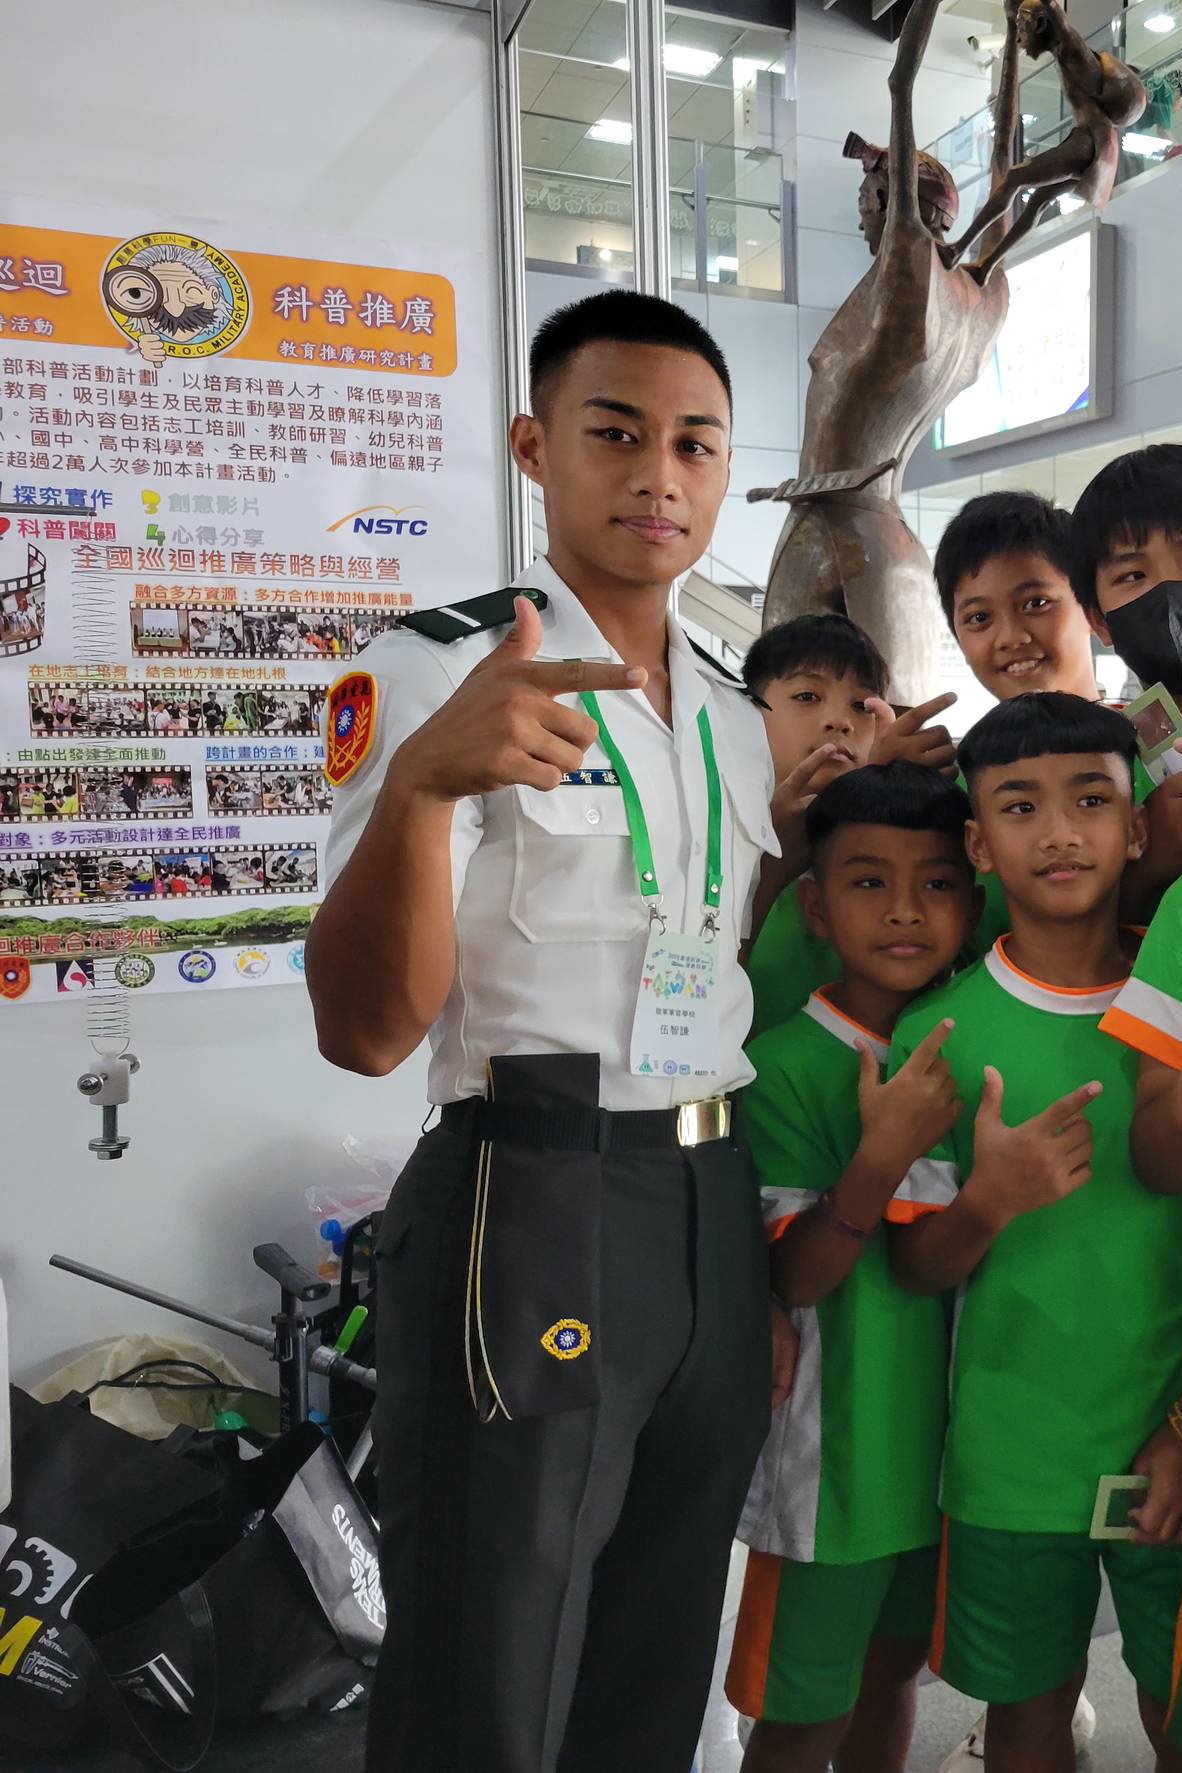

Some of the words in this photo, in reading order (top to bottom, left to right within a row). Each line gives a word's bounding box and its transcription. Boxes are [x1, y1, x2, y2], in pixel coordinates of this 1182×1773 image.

[206, 251, 247, 302] ACADEMY
[274, 286, 435, 335] 科普推廣
[211, 306, 247, 350] MILITARY
[279, 340, 433, 371] 教育推廣研究計畫
[0, 450, 290, 484] 超過2萬人次參加本計畫活動。
[13, 485, 113, 510] 探究實作
[168, 492, 259, 516] 創意影片
[17, 518, 116, 542] 科普闖關
[171, 524, 265, 548] 心得分享
[353, 517, 428, 536] NSTC
[74, 544, 400, 581] 全國巡迴推廣策略與經營
[350, 1560, 385, 1630] TEXAS
